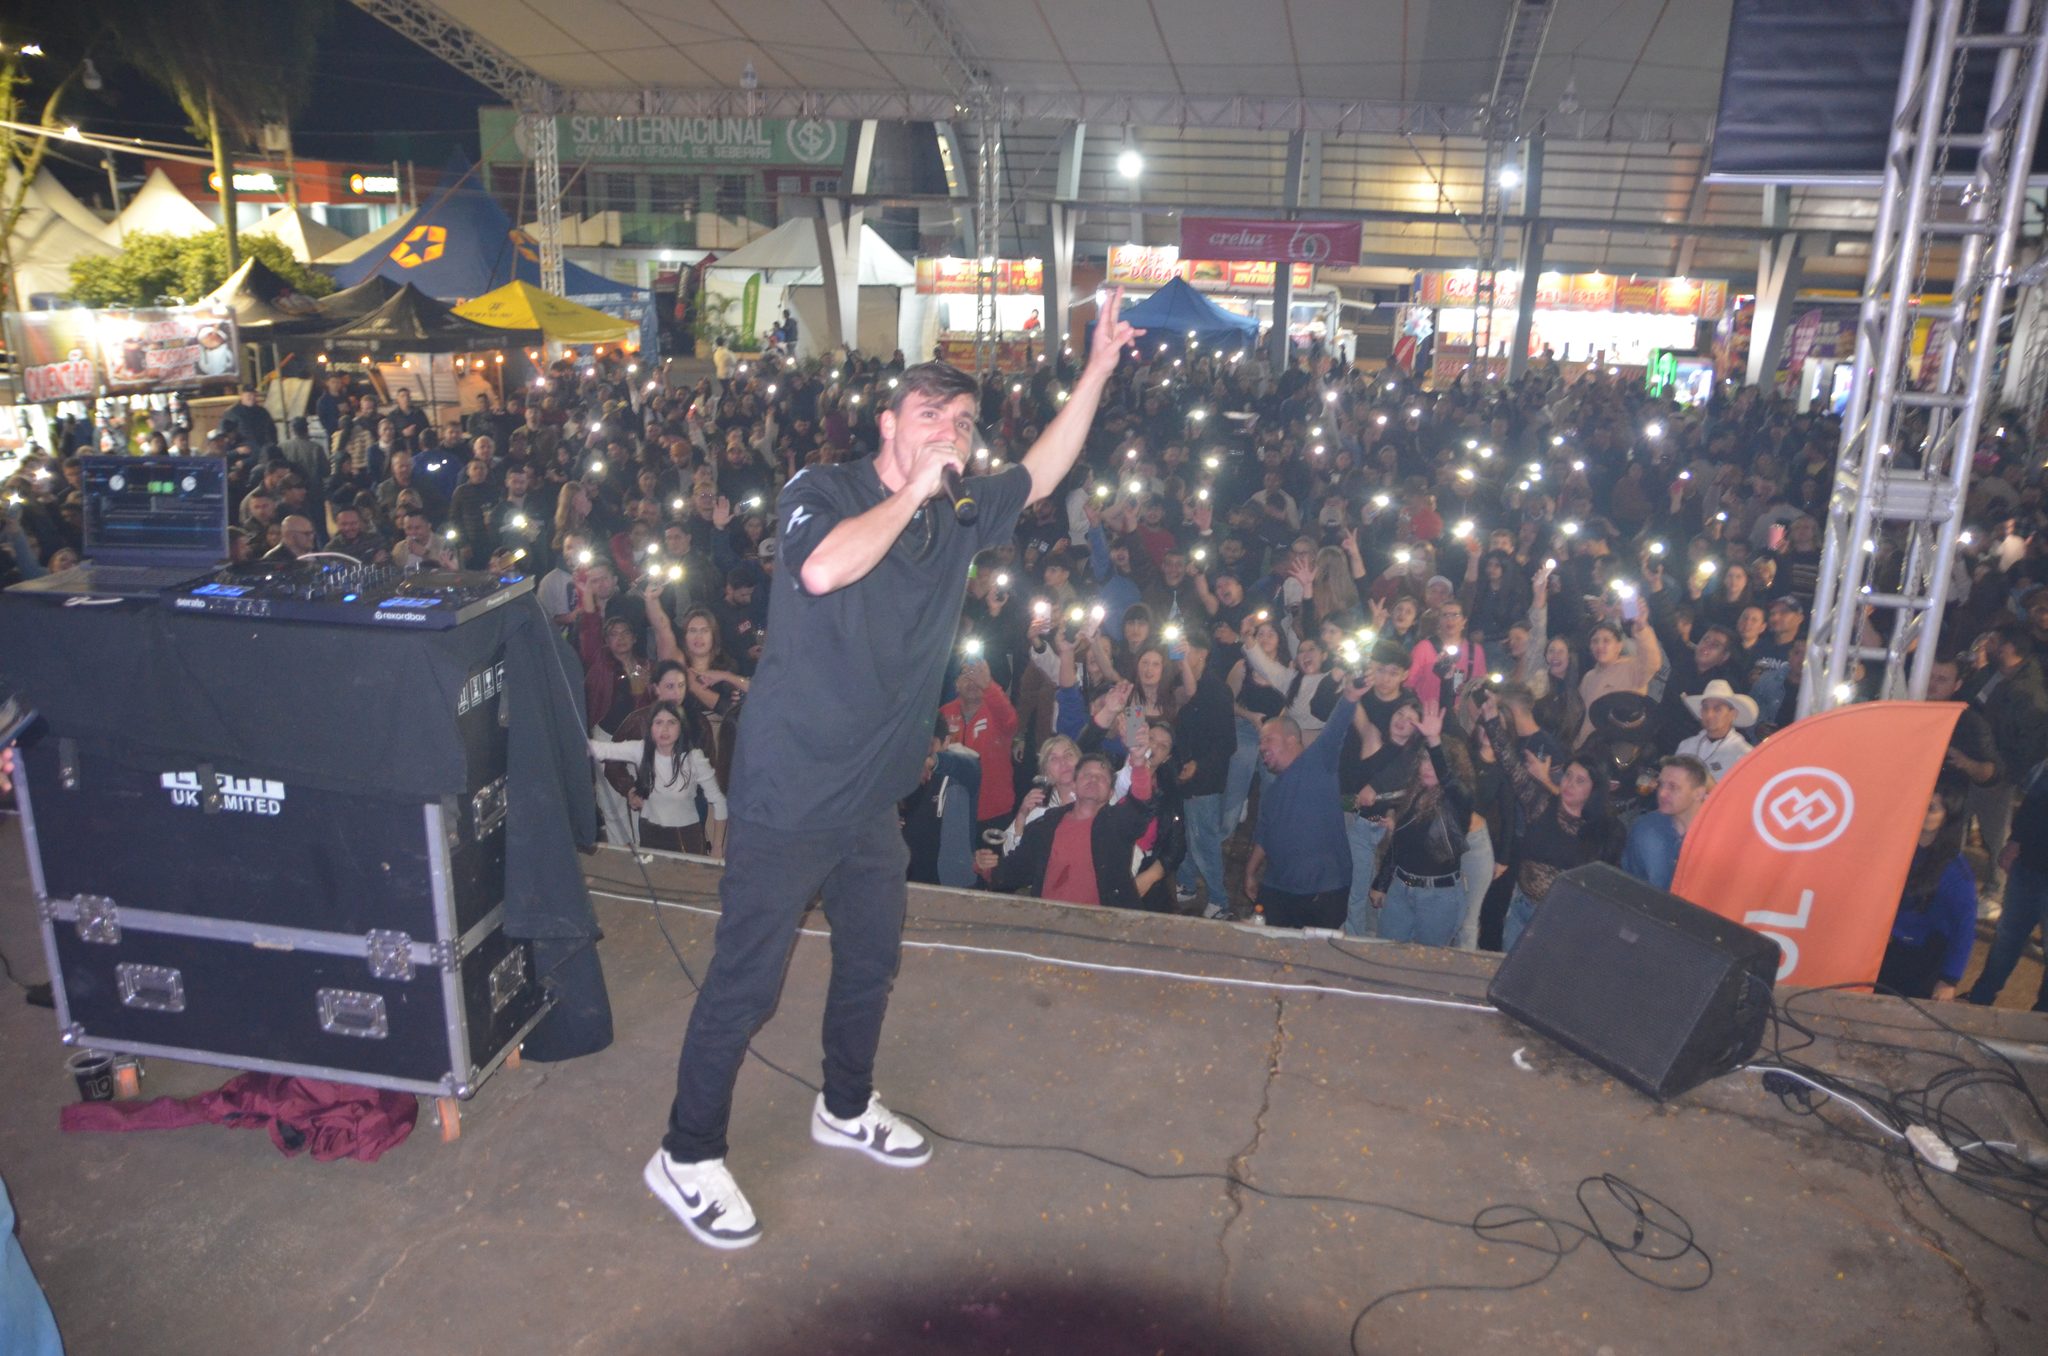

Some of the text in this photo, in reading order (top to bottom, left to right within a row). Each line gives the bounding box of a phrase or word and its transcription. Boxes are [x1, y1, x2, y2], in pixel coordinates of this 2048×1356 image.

[571, 115, 772, 145] SC INTERNACIONAL
[1209, 229, 1266, 246] creluz
[383, 611, 426, 621] rekordbox
[171, 789, 199, 807] UK
